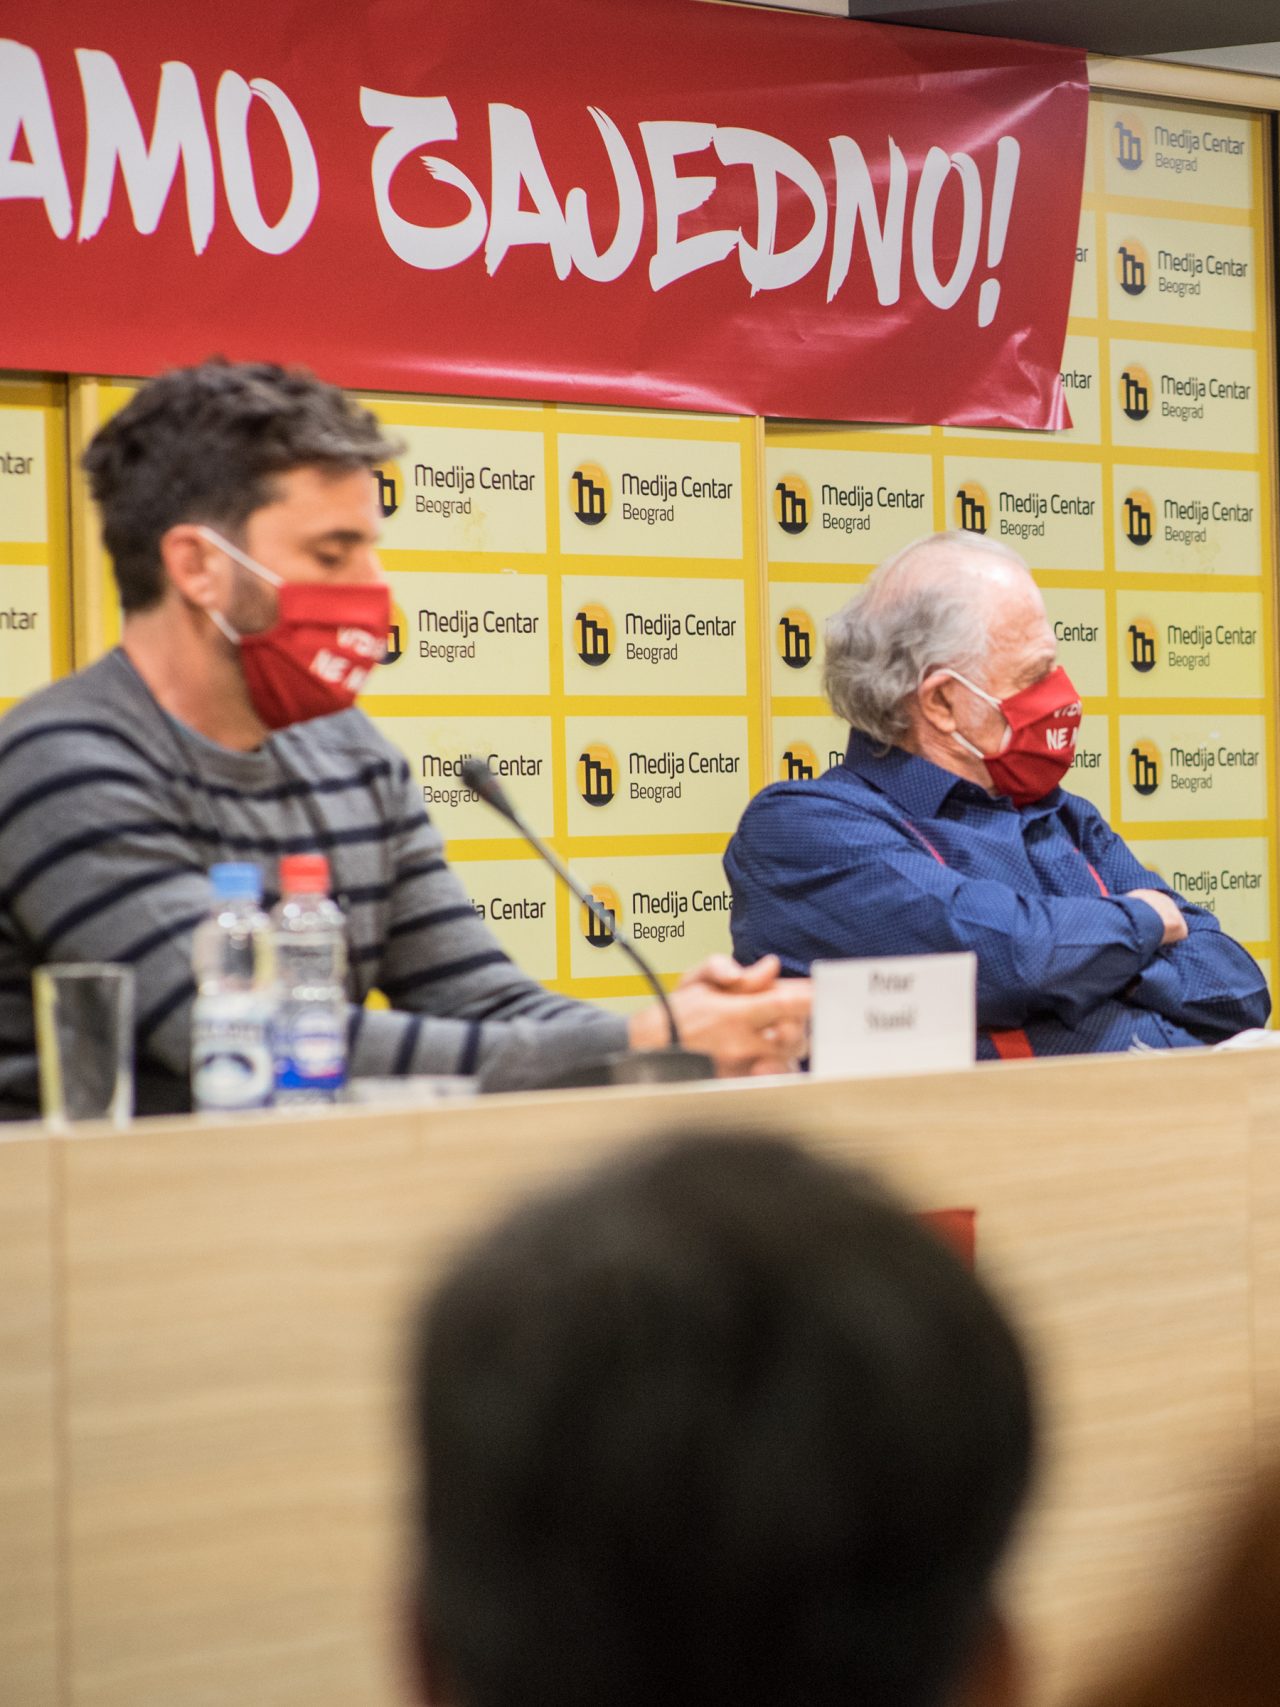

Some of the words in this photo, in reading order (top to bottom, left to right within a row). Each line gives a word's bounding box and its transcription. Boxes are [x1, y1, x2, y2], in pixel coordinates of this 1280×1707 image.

[1155, 126, 1201, 155] Medija
[1204, 132, 1245, 155] Centar
[1155, 152, 1197, 173] Beograd
[359, 86, 1021, 328] ZAJEDNO!
[1158, 250, 1203, 278] Medija
[1204, 255, 1248, 277] Centar
[1159, 275, 1200, 298] Beograd
[1060, 370, 1092, 389] entar
[1161, 375, 1206, 403] Medija
[1207, 379, 1251, 399] Centar
[1162, 401, 1203, 421] Beograd
[415, 464, 474, 494] Medija
[480, 467, 535, 491] Centar
[622, 473, 677, 502] Medija
[682, 476, 733, 499] Centar
[416, 495, 471, 518] Beograd
[822, 485, 873, 511] Medija
[874, 487, 925, 508] Centar
[1000, 492, 1047, 518] Medija
[1048, 494, 1095, 515] Centar
[623, 503, 674, 525] Beograd
[823, 513, 870, 534] Beograd
[1164, 499, 1209, 525] Medija
[1210, 502, 1253, 522] Centar
[1000, 519, 1044, 540] Beograd
[1165, 524, 1206, 545] Beograd
[419, 610, 478, 640] Medija
[483, 611, 539, 633] Centar
[626, 613, 681, 641] Medija
[685, 614, 736, 636] Centar
[1054, 621, 1098, 642] Centar
[1168, 625, 1212, 649] Medija
[1213, 625, 1256, 645] Centar
[420, 641, 475, 662] Beograd
[627, 643, 677, 664] Beograd
[1168, 649, 1210, 670] Beograd
[1046, 728, 1069, 750] NE
[423, 754, 472, 778] Med
[487, 754, 543, 776] Centar
[630, 752, 684, 779] Medija
[689, 752, 740, 773] Centar
[1073, 750, 1102, 768] ntar
[1170, 748, 1215, 771] Medija
[1216, 747, 1259, 766] Centar
[630, 782, 681, 803] Beograd
[1171, 774, 1212, 793] Beograd
[423, 785, 480, 807] Beograd
[1173, 872, 1217, 895] Medija
[1221, 870, 1262, 889] Centar
[490, 898, 546, 920] Centar
[633, 891, 687, 918] Medija
[692, 890, 733, 912] Cent
[634, 921, 684, 942] Beograd
